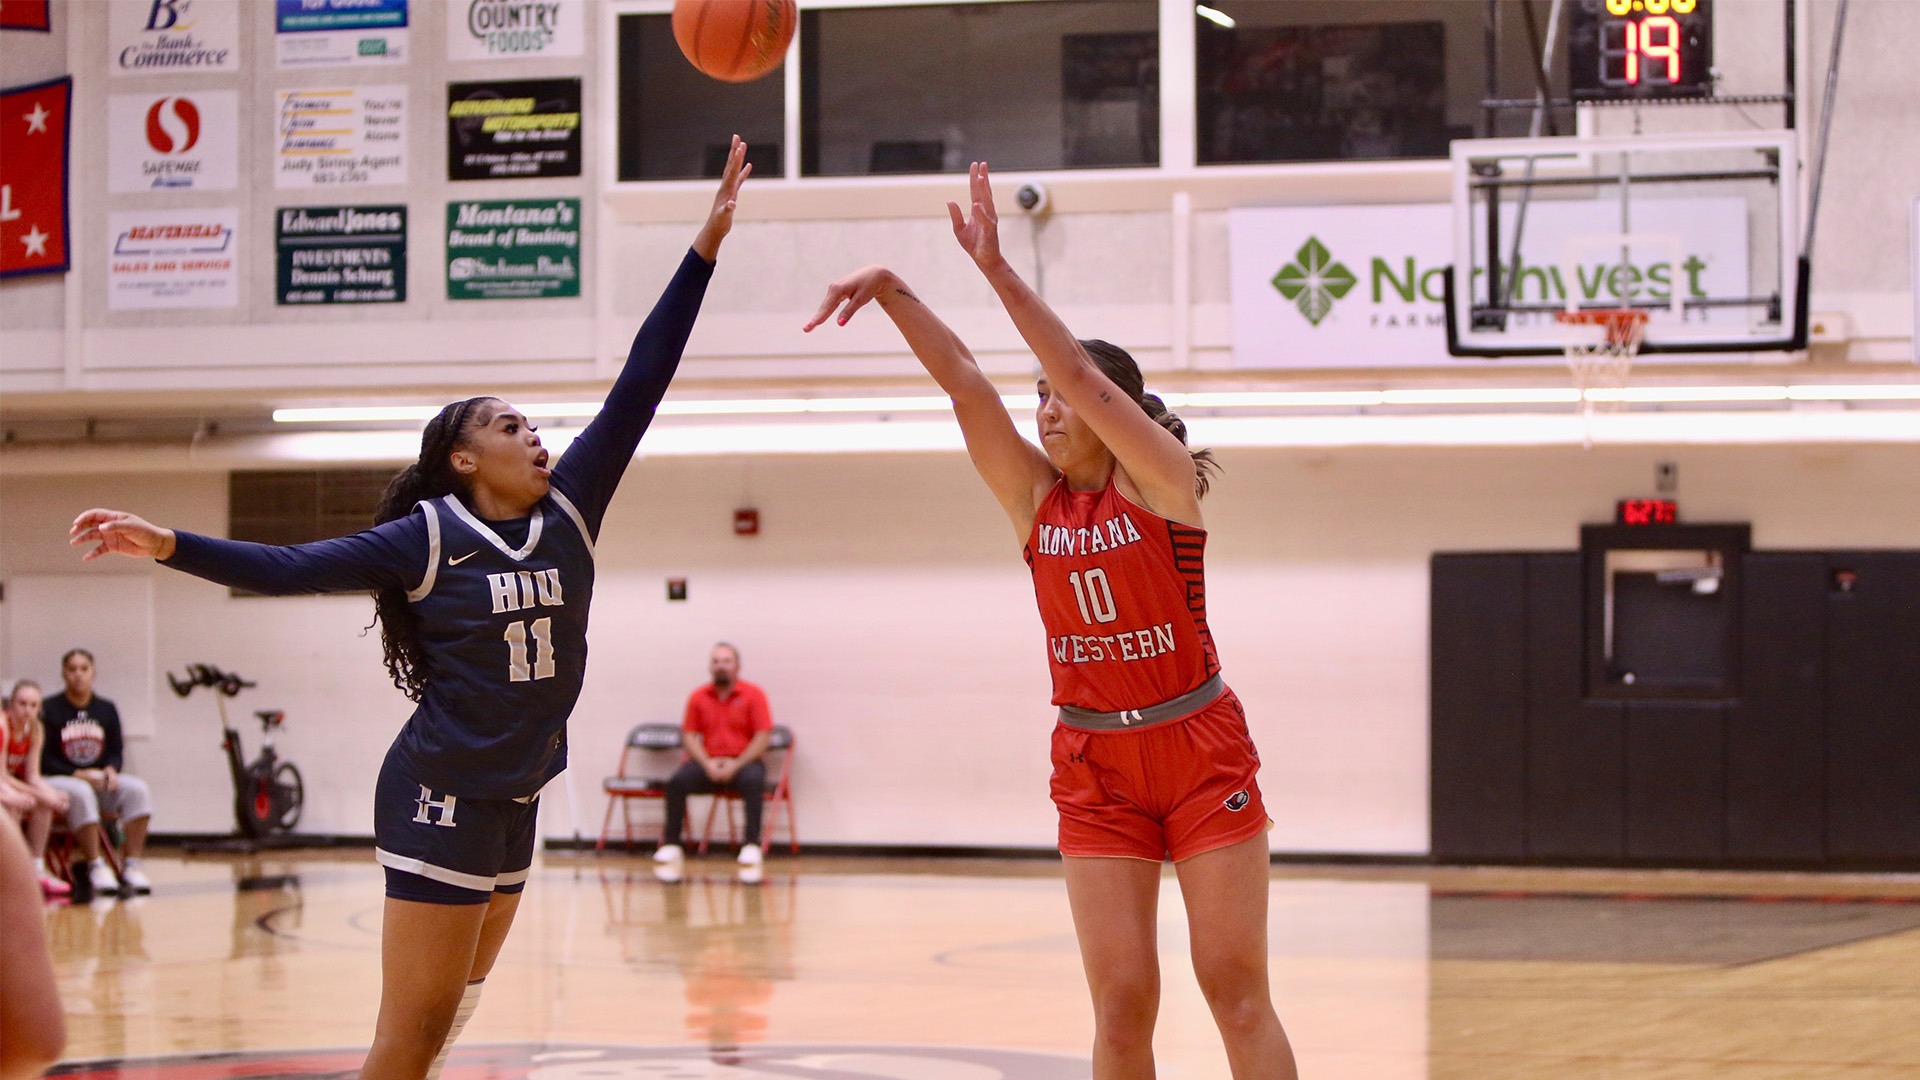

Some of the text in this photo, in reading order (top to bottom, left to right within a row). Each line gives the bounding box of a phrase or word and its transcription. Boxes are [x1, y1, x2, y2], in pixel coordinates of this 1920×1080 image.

[118, 45, 229, 69] Commerce
[155, 34, 193, 50] Bank
[487, 29, 545, 53] FOODS
[1625, 16, 1680, 84] 19
[456, 201, 574, 227] Montana's
[449, 227, 578, 249] Brand of Banking
[1371, 256, 1707, 303] Norhwest
[1037, 512, 1142, 557] MONTANA
[486, 568, 564, 614] HIU
[1069, 567, 1118, 626] 10
[503, 616, 556, 683] 11
[1051, 622, 1176, 665] WESTERN
